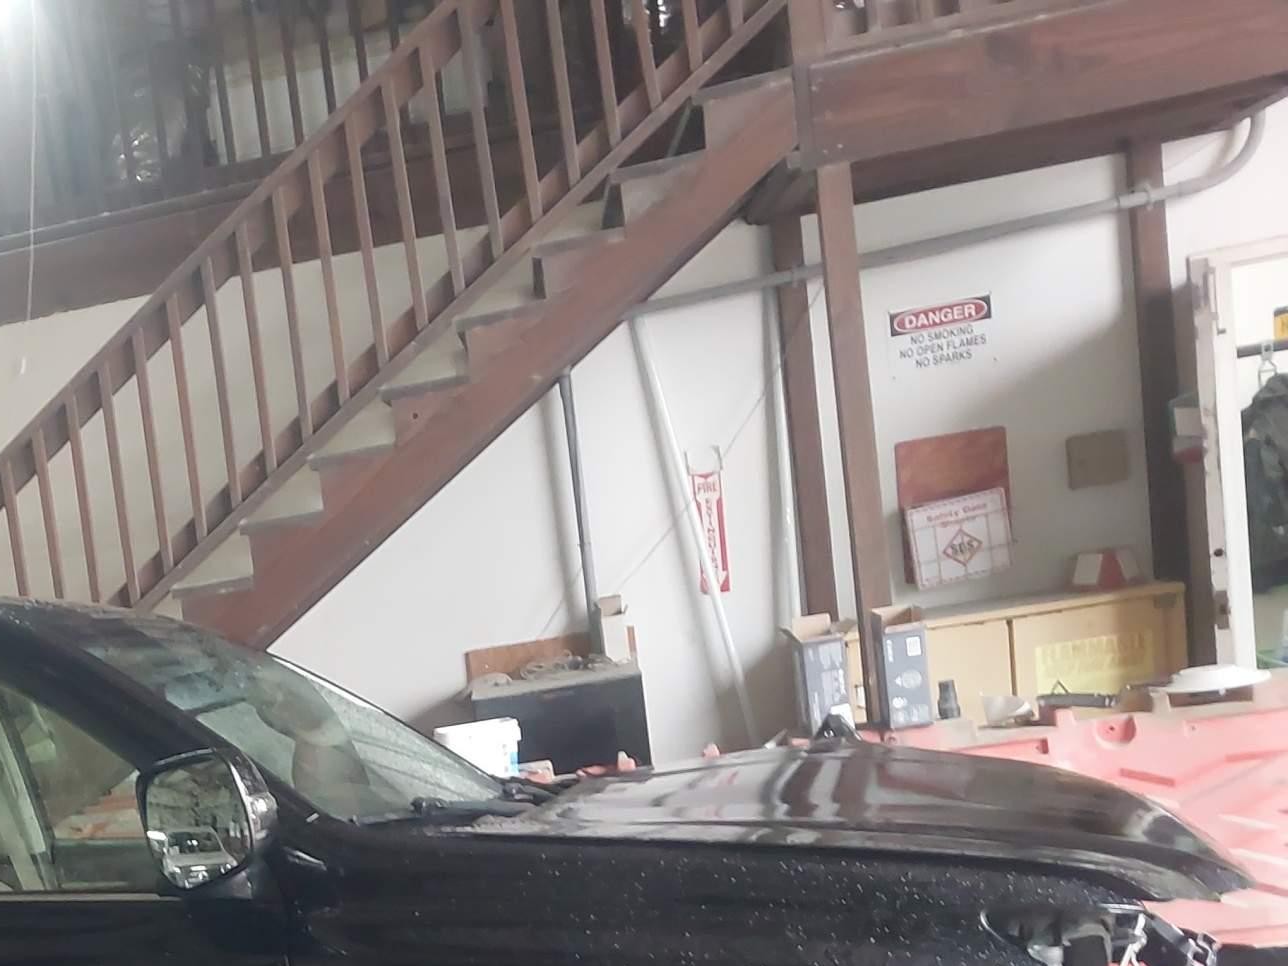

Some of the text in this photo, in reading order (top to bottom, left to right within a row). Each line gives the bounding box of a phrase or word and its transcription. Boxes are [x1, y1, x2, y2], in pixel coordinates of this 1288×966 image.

[904, 303, 976, 329] DANGER
[899, 333, 987, 359] NO OPEN FLAMES
[910, 323, 974, 345] NO SMOKING
[915, 349, 973, 369] NO SPARKS
